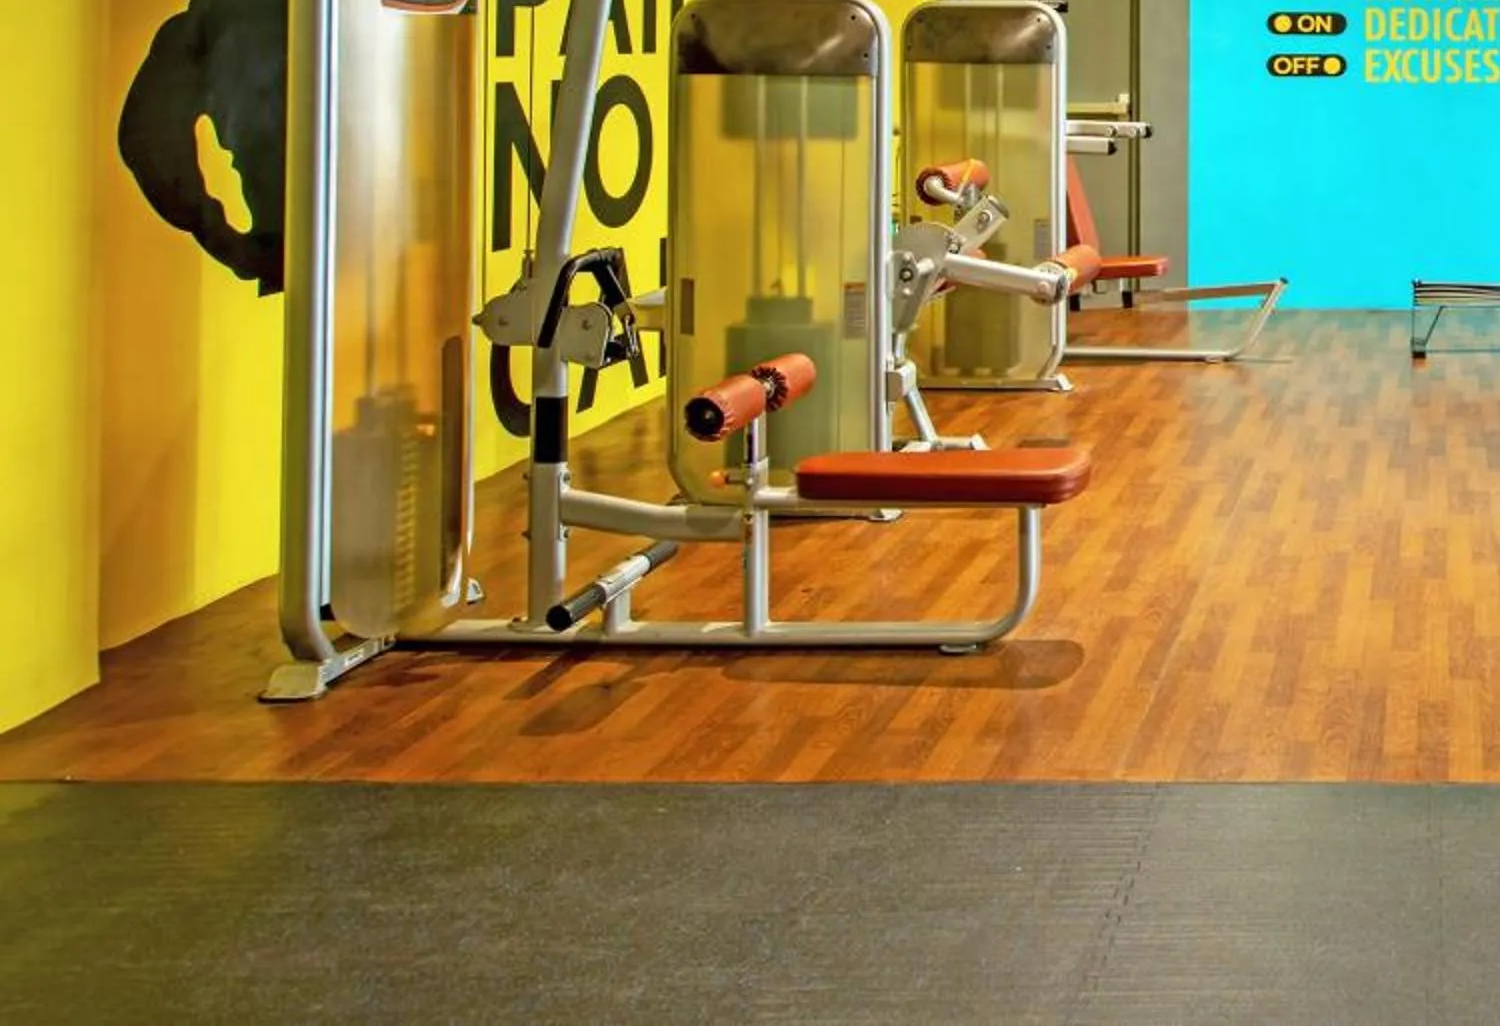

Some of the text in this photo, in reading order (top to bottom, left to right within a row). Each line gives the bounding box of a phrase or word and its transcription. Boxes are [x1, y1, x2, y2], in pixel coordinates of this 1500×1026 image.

[1297, 15, 1332, 33] ON
[1273, 57, 1319, 75] OFF
[492, 74, 653, 253] NO
